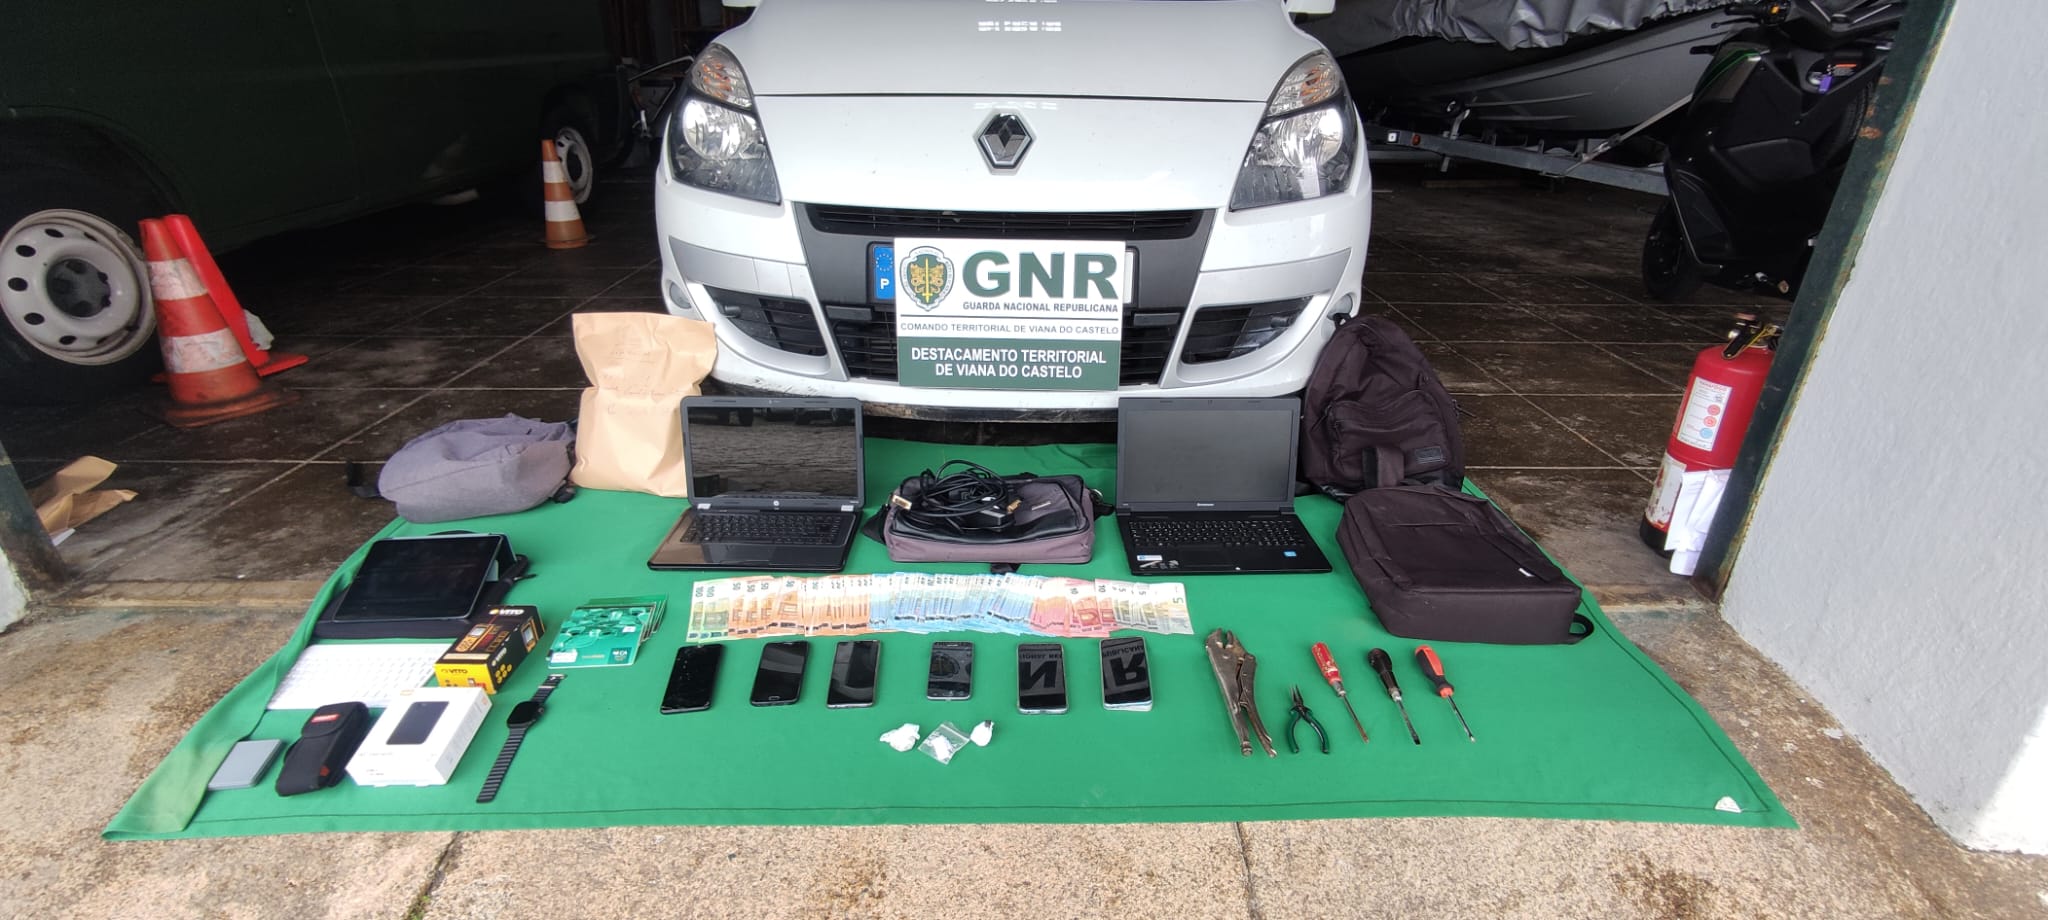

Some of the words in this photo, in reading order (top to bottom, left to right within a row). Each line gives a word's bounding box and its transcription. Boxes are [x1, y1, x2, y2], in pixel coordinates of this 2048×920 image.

[962, 250, 1119, 300] GNR
[880, 277, 890, 290] P
[962, 302, 1001, 311] GUARDA
[1003, 302, 1051, 312] NACIONAL
[1053, 303, 1119, 313] REPUBLICANA
[900, 322, 949, 331] COMANDO
[951, 324, 1012, 333] TERRITORIAL
[1013, 325, 1027, 333] DE
[1029, 325, 1057, 333] VIANA
[1059, 326, 1073, 334] DO
[1075, 326, 1119, 335] CASTELO
[911, 347, 1018, 362] DESTACAMENTO
[1021, 349, 1107, 364] TERRITORIAL
[935, 363, 953, 376] DE
[956, 363, 996, 377] VIANA
[999, 364, 1018, 377] DO
[1021, 365, 1082, 378] CASTELO
